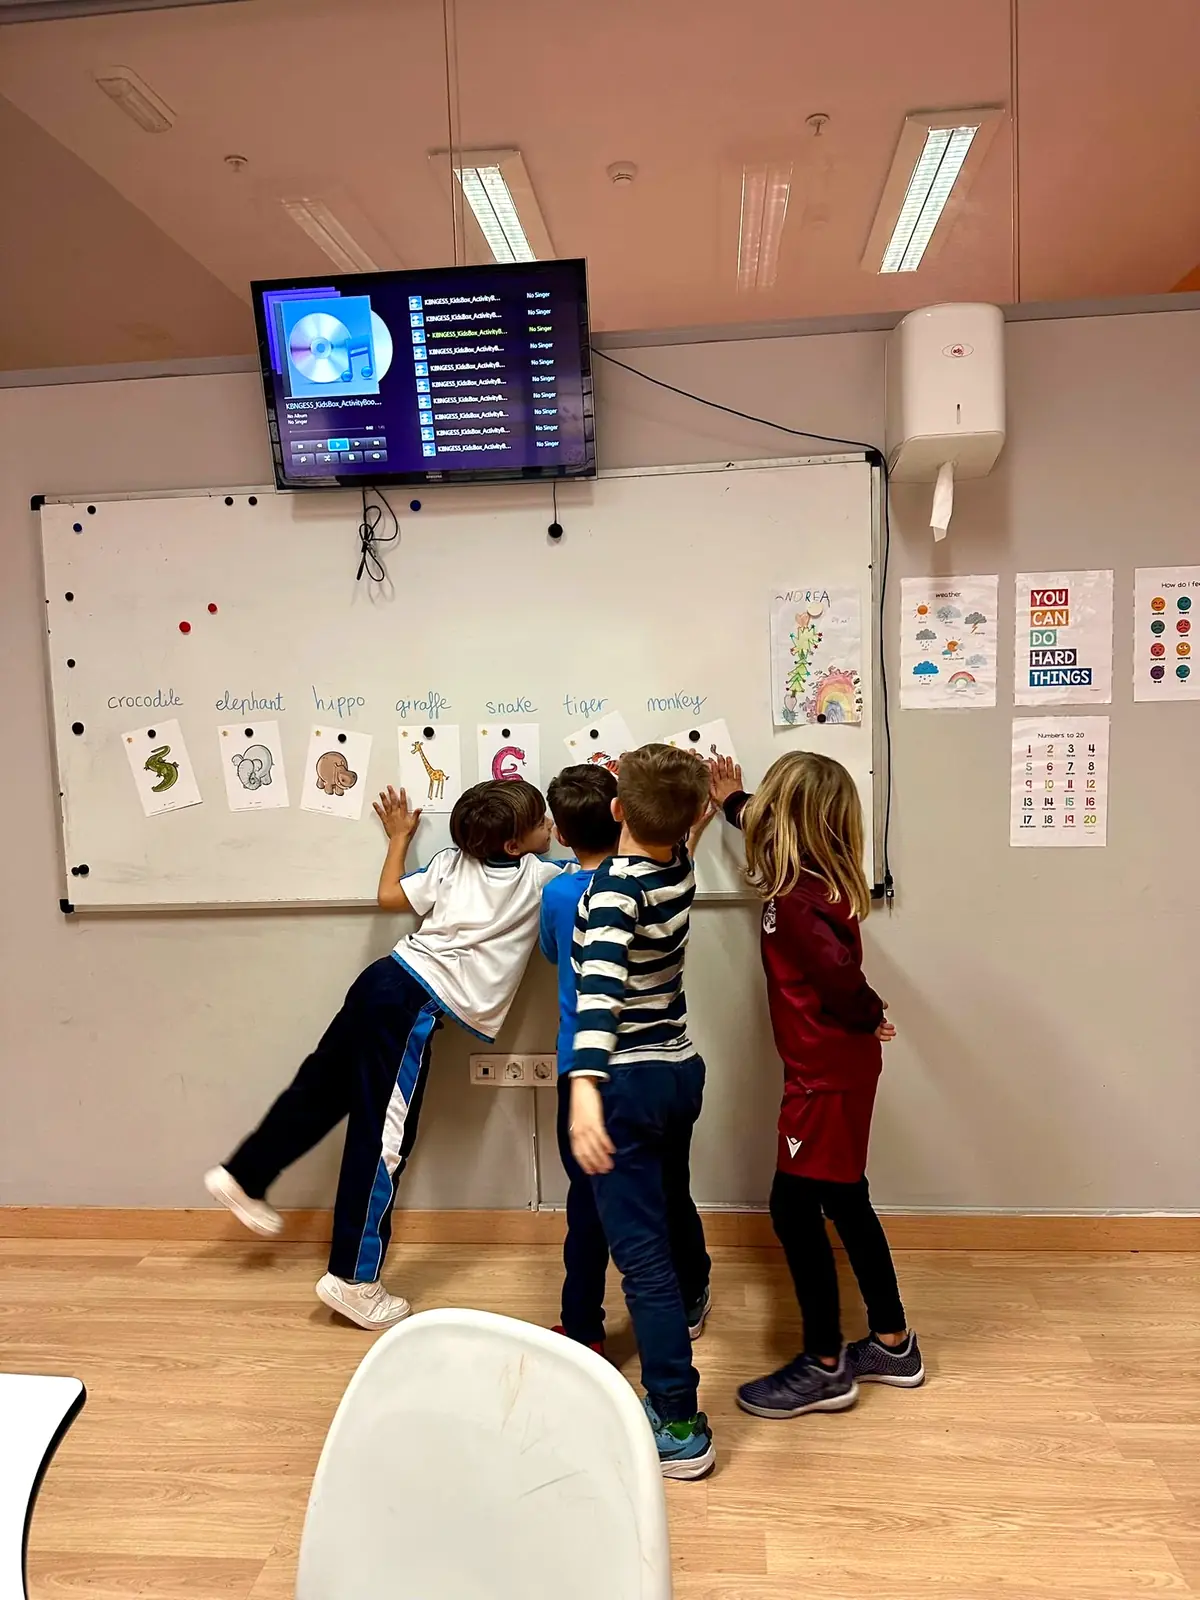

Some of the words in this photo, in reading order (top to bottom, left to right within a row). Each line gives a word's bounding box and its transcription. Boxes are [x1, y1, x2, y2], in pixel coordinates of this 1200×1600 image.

[1033, 591, 1066, 605] YOU
[1032, 610, 1066, 625] CAN
[1032, 632, 1054, 645] DO
[1032, 651, 1074, 665] HARD
[1032, 670, 1089, 685] THINGS
[107, 689, 184, 709] crocodile
[215, 690, 286, 715] elephant
[312, 686, 365, 717] hippo
[395, 691, 452, 719] giraffe
[485, 697, 538, 715] snake
[562, 695, 608, 716] tiger
[647, 690, 708, 715] monkey
[1047, 744, 1054, 753] 2
[1068, 744, 1074, 753] 3
[1088, 744, 1095, 753] 4
[1026, 762, 1032, 771] 5
[1047, 762, 1053, 771] 6
[1068, 762, 1073, 771] 7
[1088, 762, 1094, 770] 8
[1026, 780, 1032, 788] 9
[1045, 780, 1054, 788] 10
[1087, 780, 1095, 788] 12
[1024, 798, 1033, 806] 13
[1044, 798, 1054, 806] 14
[1066, 798, 1074, 806] 15
[1086, 798, 1095, 806] 16
[1024, 816, 1032, 824] 17
[1044, 815, 1053, 824] 18
[1065, 815, 1074, 824] 19
[1084, 815, 1096, 824] 20
